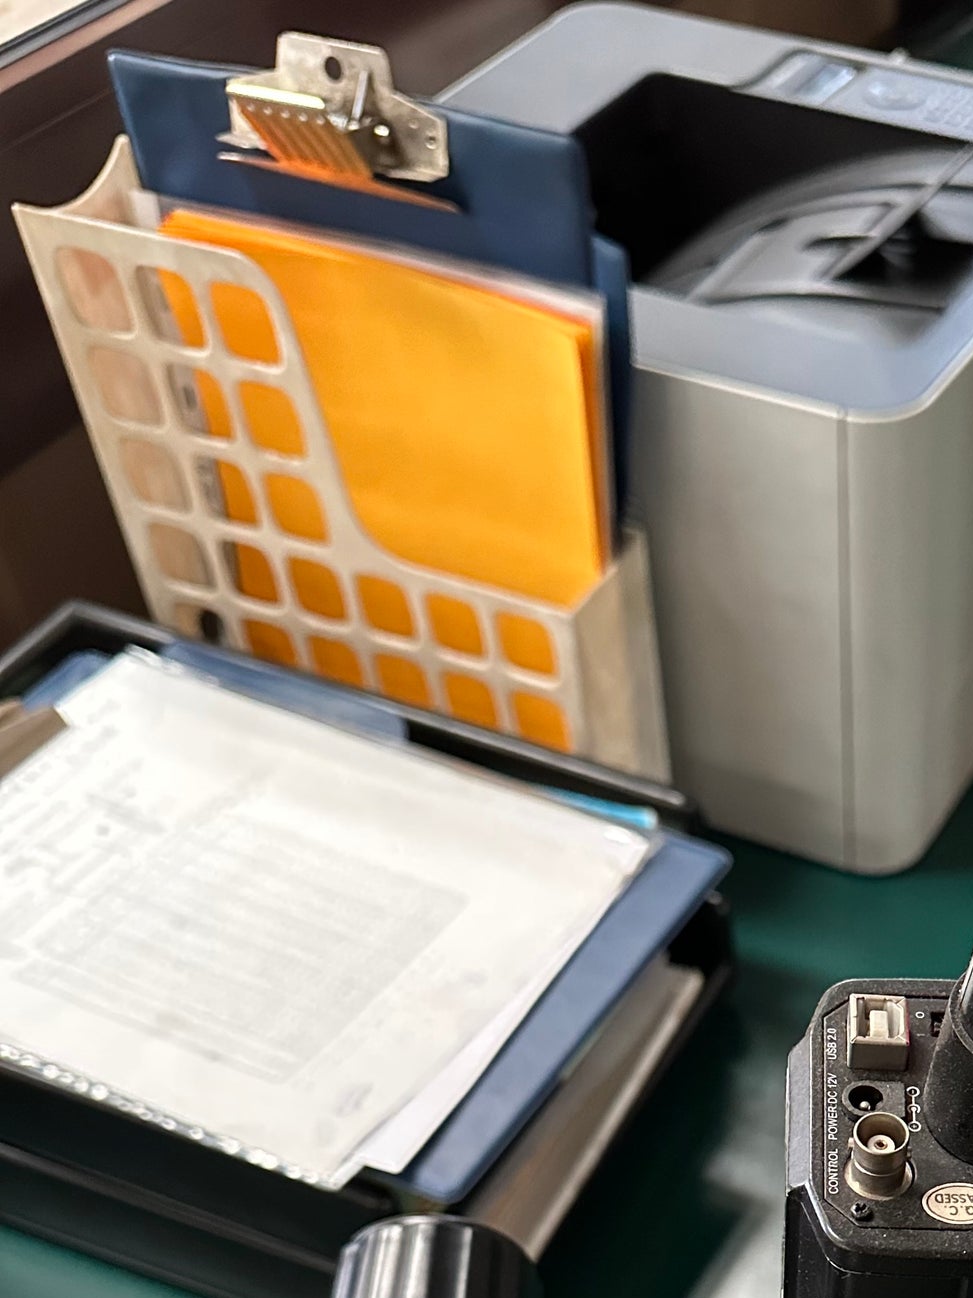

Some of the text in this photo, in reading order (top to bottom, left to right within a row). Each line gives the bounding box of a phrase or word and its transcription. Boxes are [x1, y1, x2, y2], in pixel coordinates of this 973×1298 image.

[827, 1028, 837, 1060] USB 2.0
[827, 1072, 838, 1090] 12V
[828, 1148, 839, 1195] CONTROL
